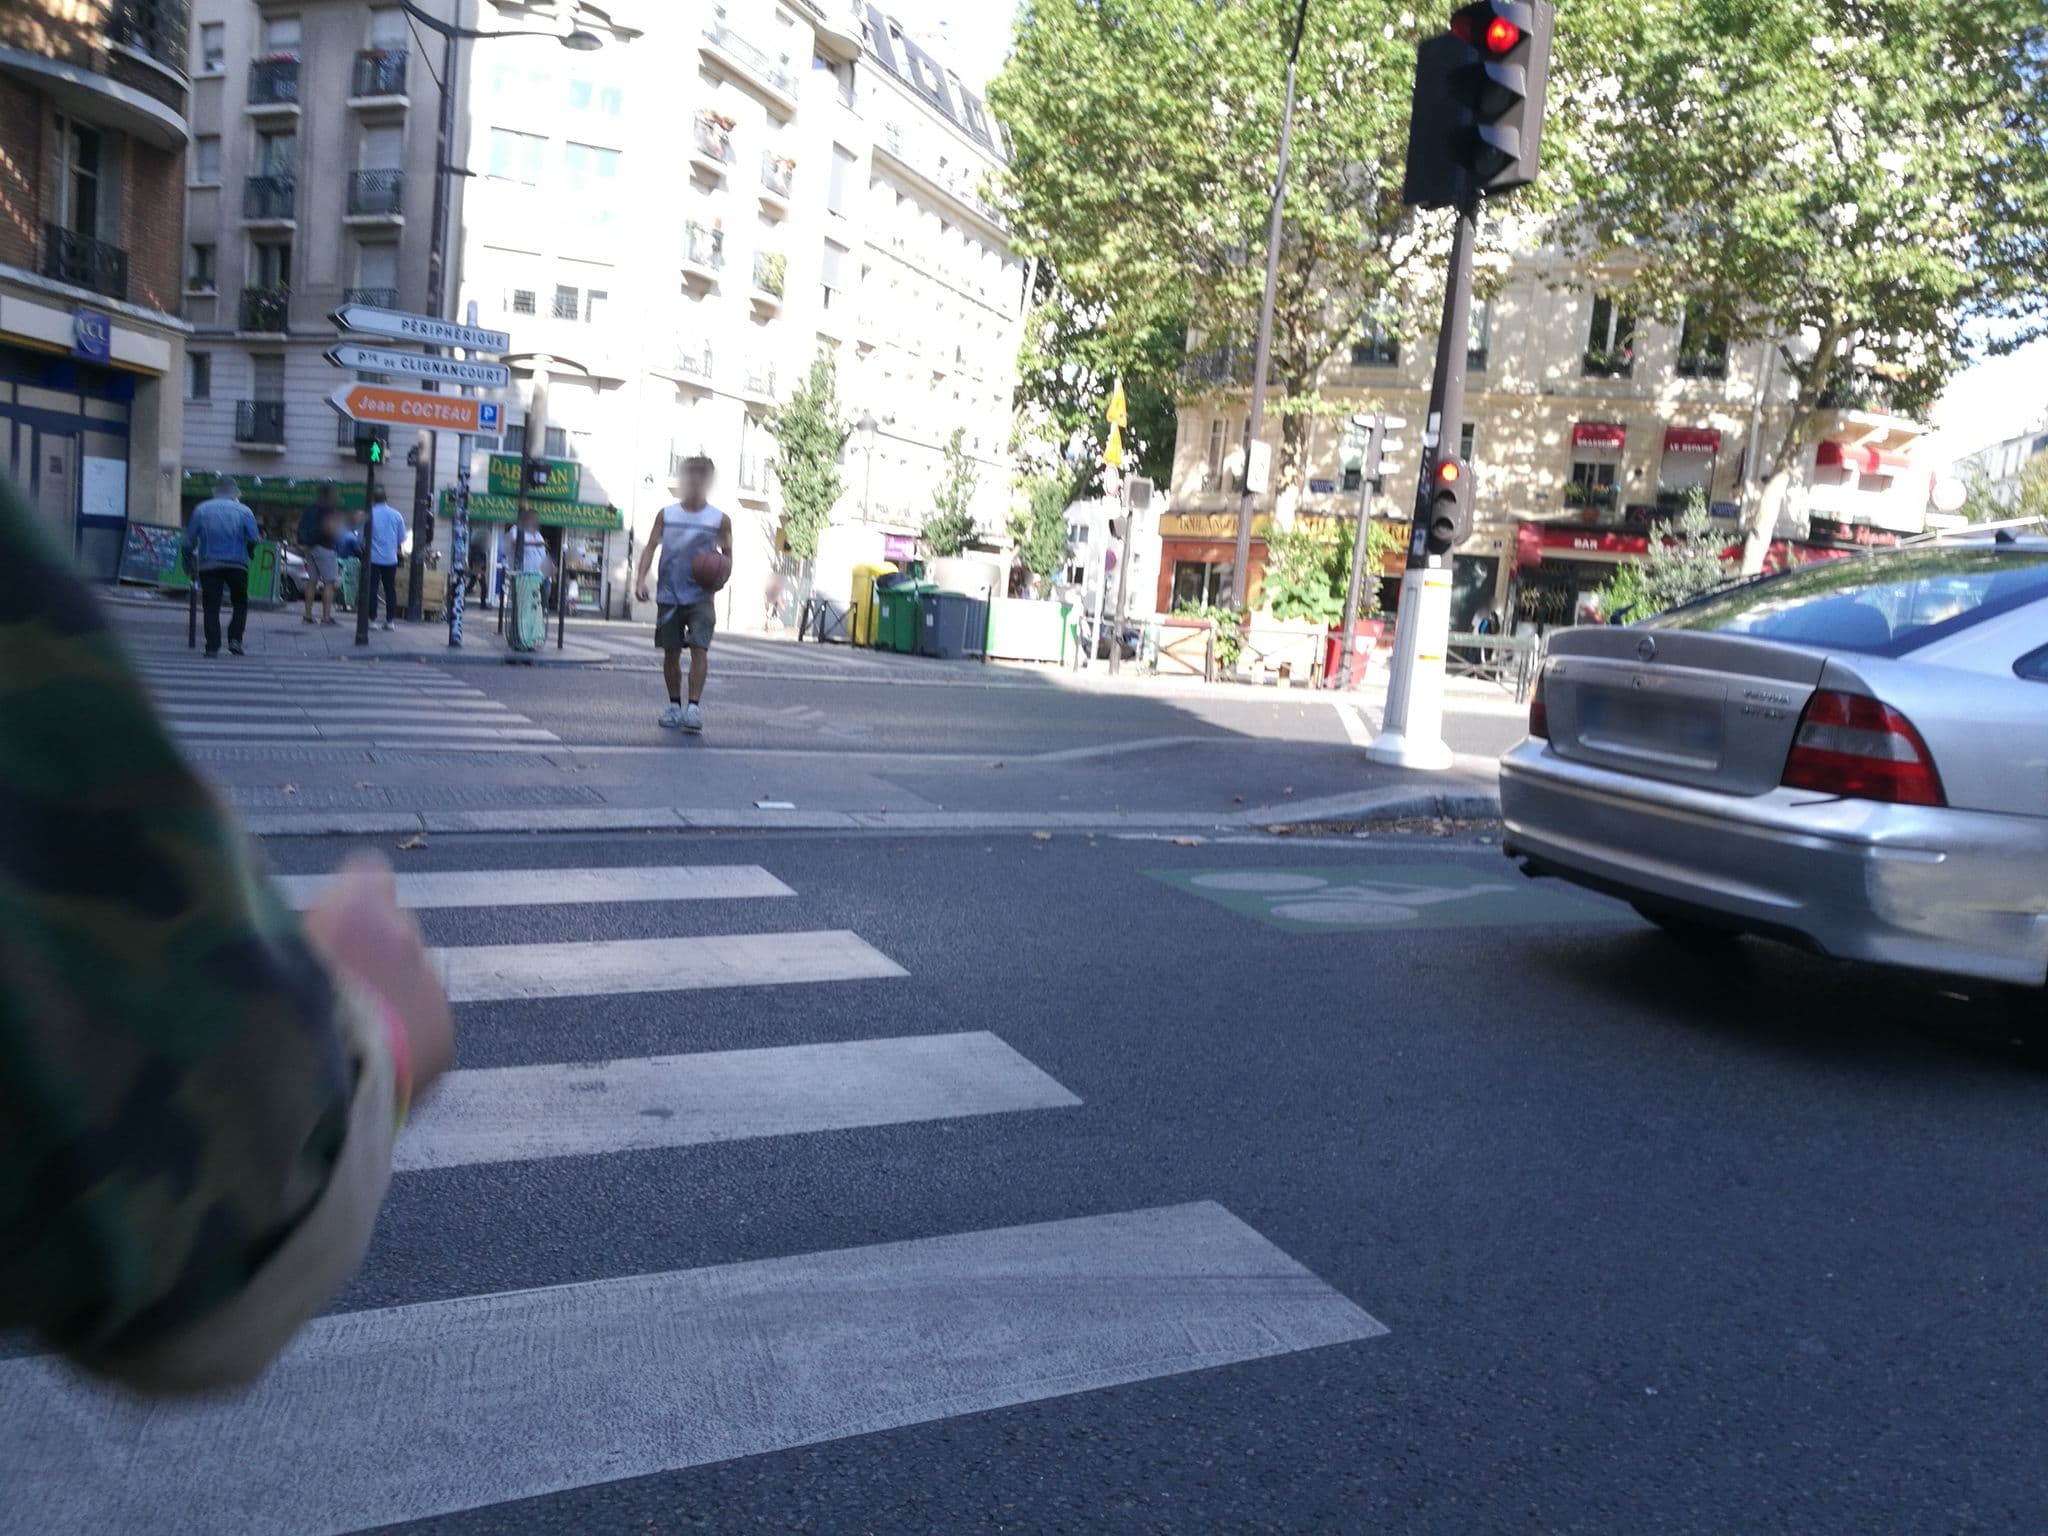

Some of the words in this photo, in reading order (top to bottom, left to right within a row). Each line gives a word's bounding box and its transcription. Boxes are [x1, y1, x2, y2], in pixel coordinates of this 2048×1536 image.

[401, 356, 501, 381] CLIGNANCOURT
[358, 394, 395, 412] Jean
[400, 400, 472, 422] COCTEAU
[1574, 538, 1598, 550] BAR
